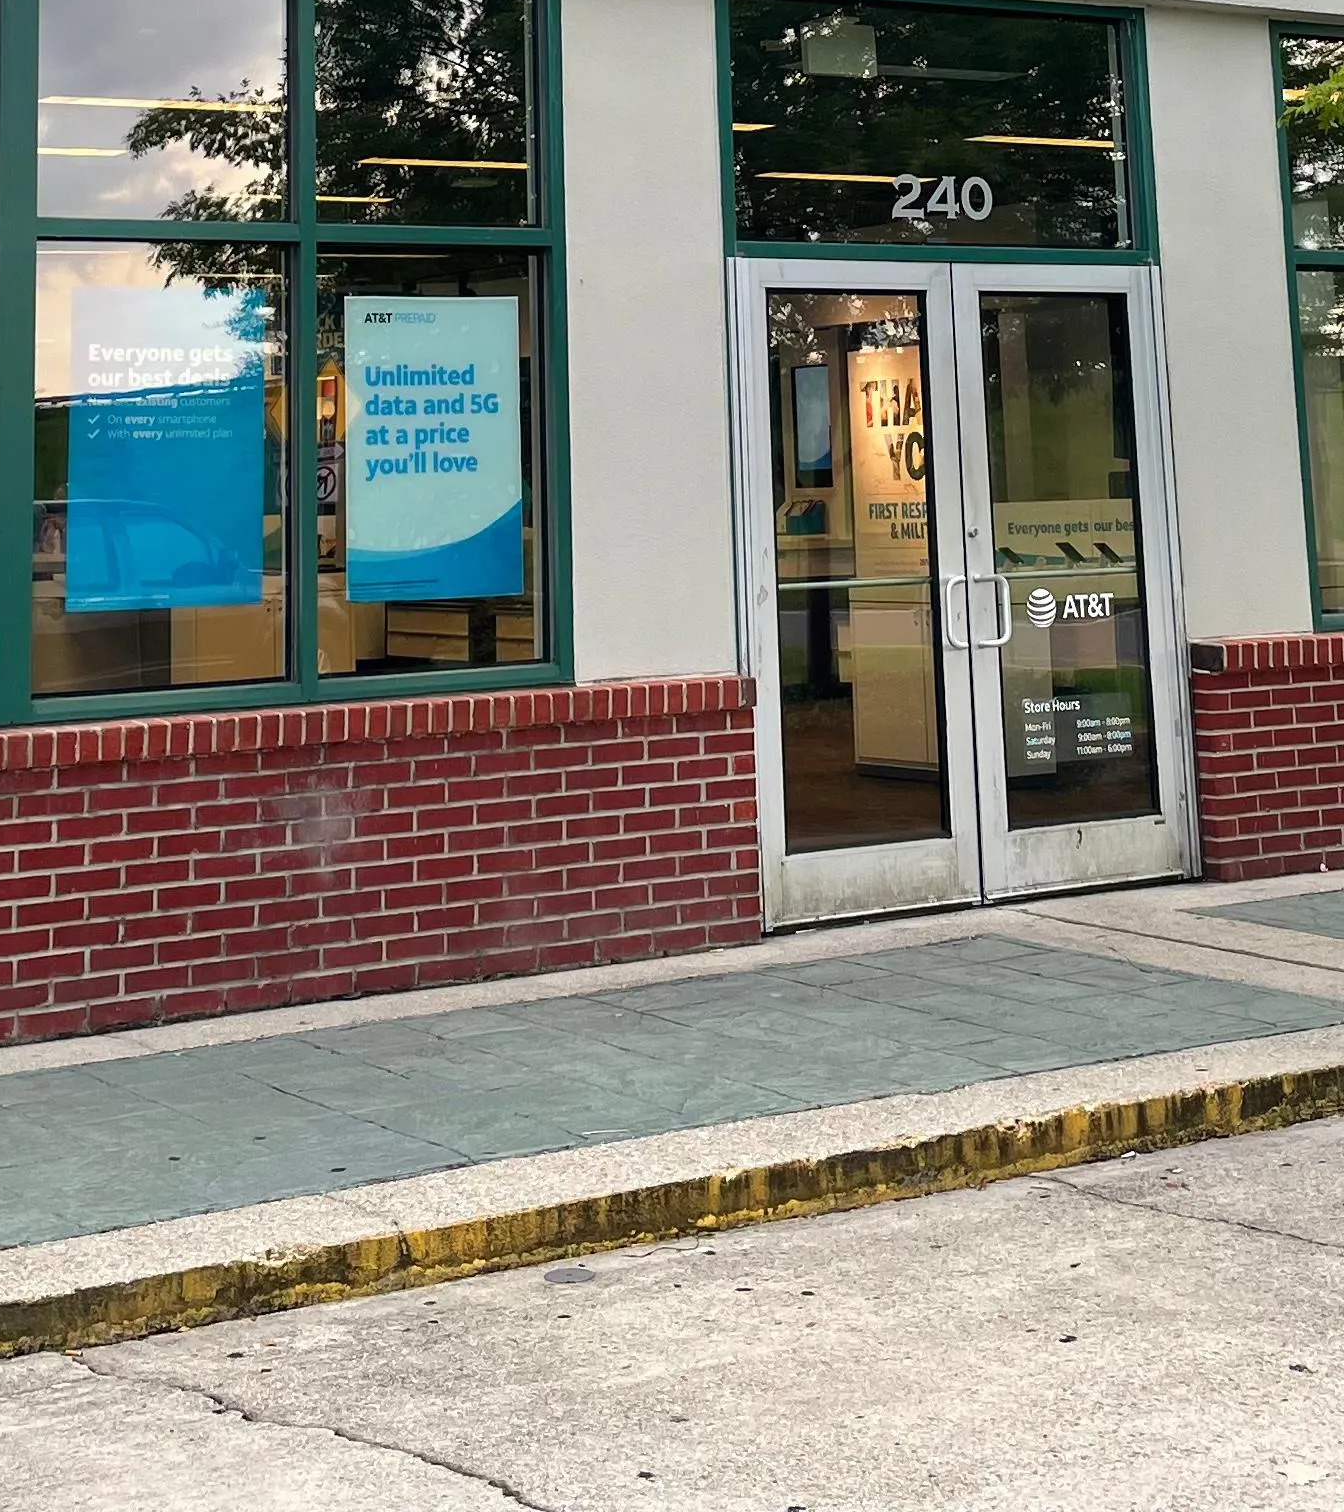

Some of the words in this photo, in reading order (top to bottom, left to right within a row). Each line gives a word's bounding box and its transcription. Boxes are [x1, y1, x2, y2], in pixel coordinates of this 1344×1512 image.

[892, 174, 993, 221] 240
[364, 312, 392, 324] AT&T
[395, 313, 436, 324] PREPAID
[88, 344, 184, 367] Everyone
[189, 345, 233, 367] gets
[88, 372, 124, 387] our
[129, 368, 172, 387] best
[177, 368, 230, 386] deals
[365, 364, 475, 386] Unlimited
[136, 396, 178, 408] existing
[179, 397, 230, 406] customers
[365, 395, 417, 416] data
[424, 393, 464, 415] and
[471, 393, 499, 414] 5G
[860, 378, 923, 428] THA
[108, 415, 122, 424] On
[125, 416, 155, 426] every
[157, 415, 216, 425] smartphone
[108, 429, 130, 438] With
[133, 430, 163, 440] every
[165, 428, 210, 438] unlimited
[213, 428, 233, 439] plan
[366, 426, 389, 445] at
[396, 428, 408, 445] a
[415, 423, 470, 450] price
[884, 431, 926, 481] YO
[366, 452, 426, 482] you'll
[433, 453, 478, 473] love
[868, 503, 898, 520] FIRST
[890, 523, 899, 539] &
[1008, 522, 1061, 538] Everyone
[1064, 522, 1088, 536] gets
[1094, 521, 1113, 532] our
[1116, 519, 1134, 531] bes
[1062, 592, 1114, 619] AT&T
[1024, 702, 1051, 714] Store
[1052, 700, 1080, 711] Hours
[1025, 721, 1051, 732] Mon-Fri
[1026, 736, 1056, 746] Saturday
[1026, 749, 1051, 760] Sunday
